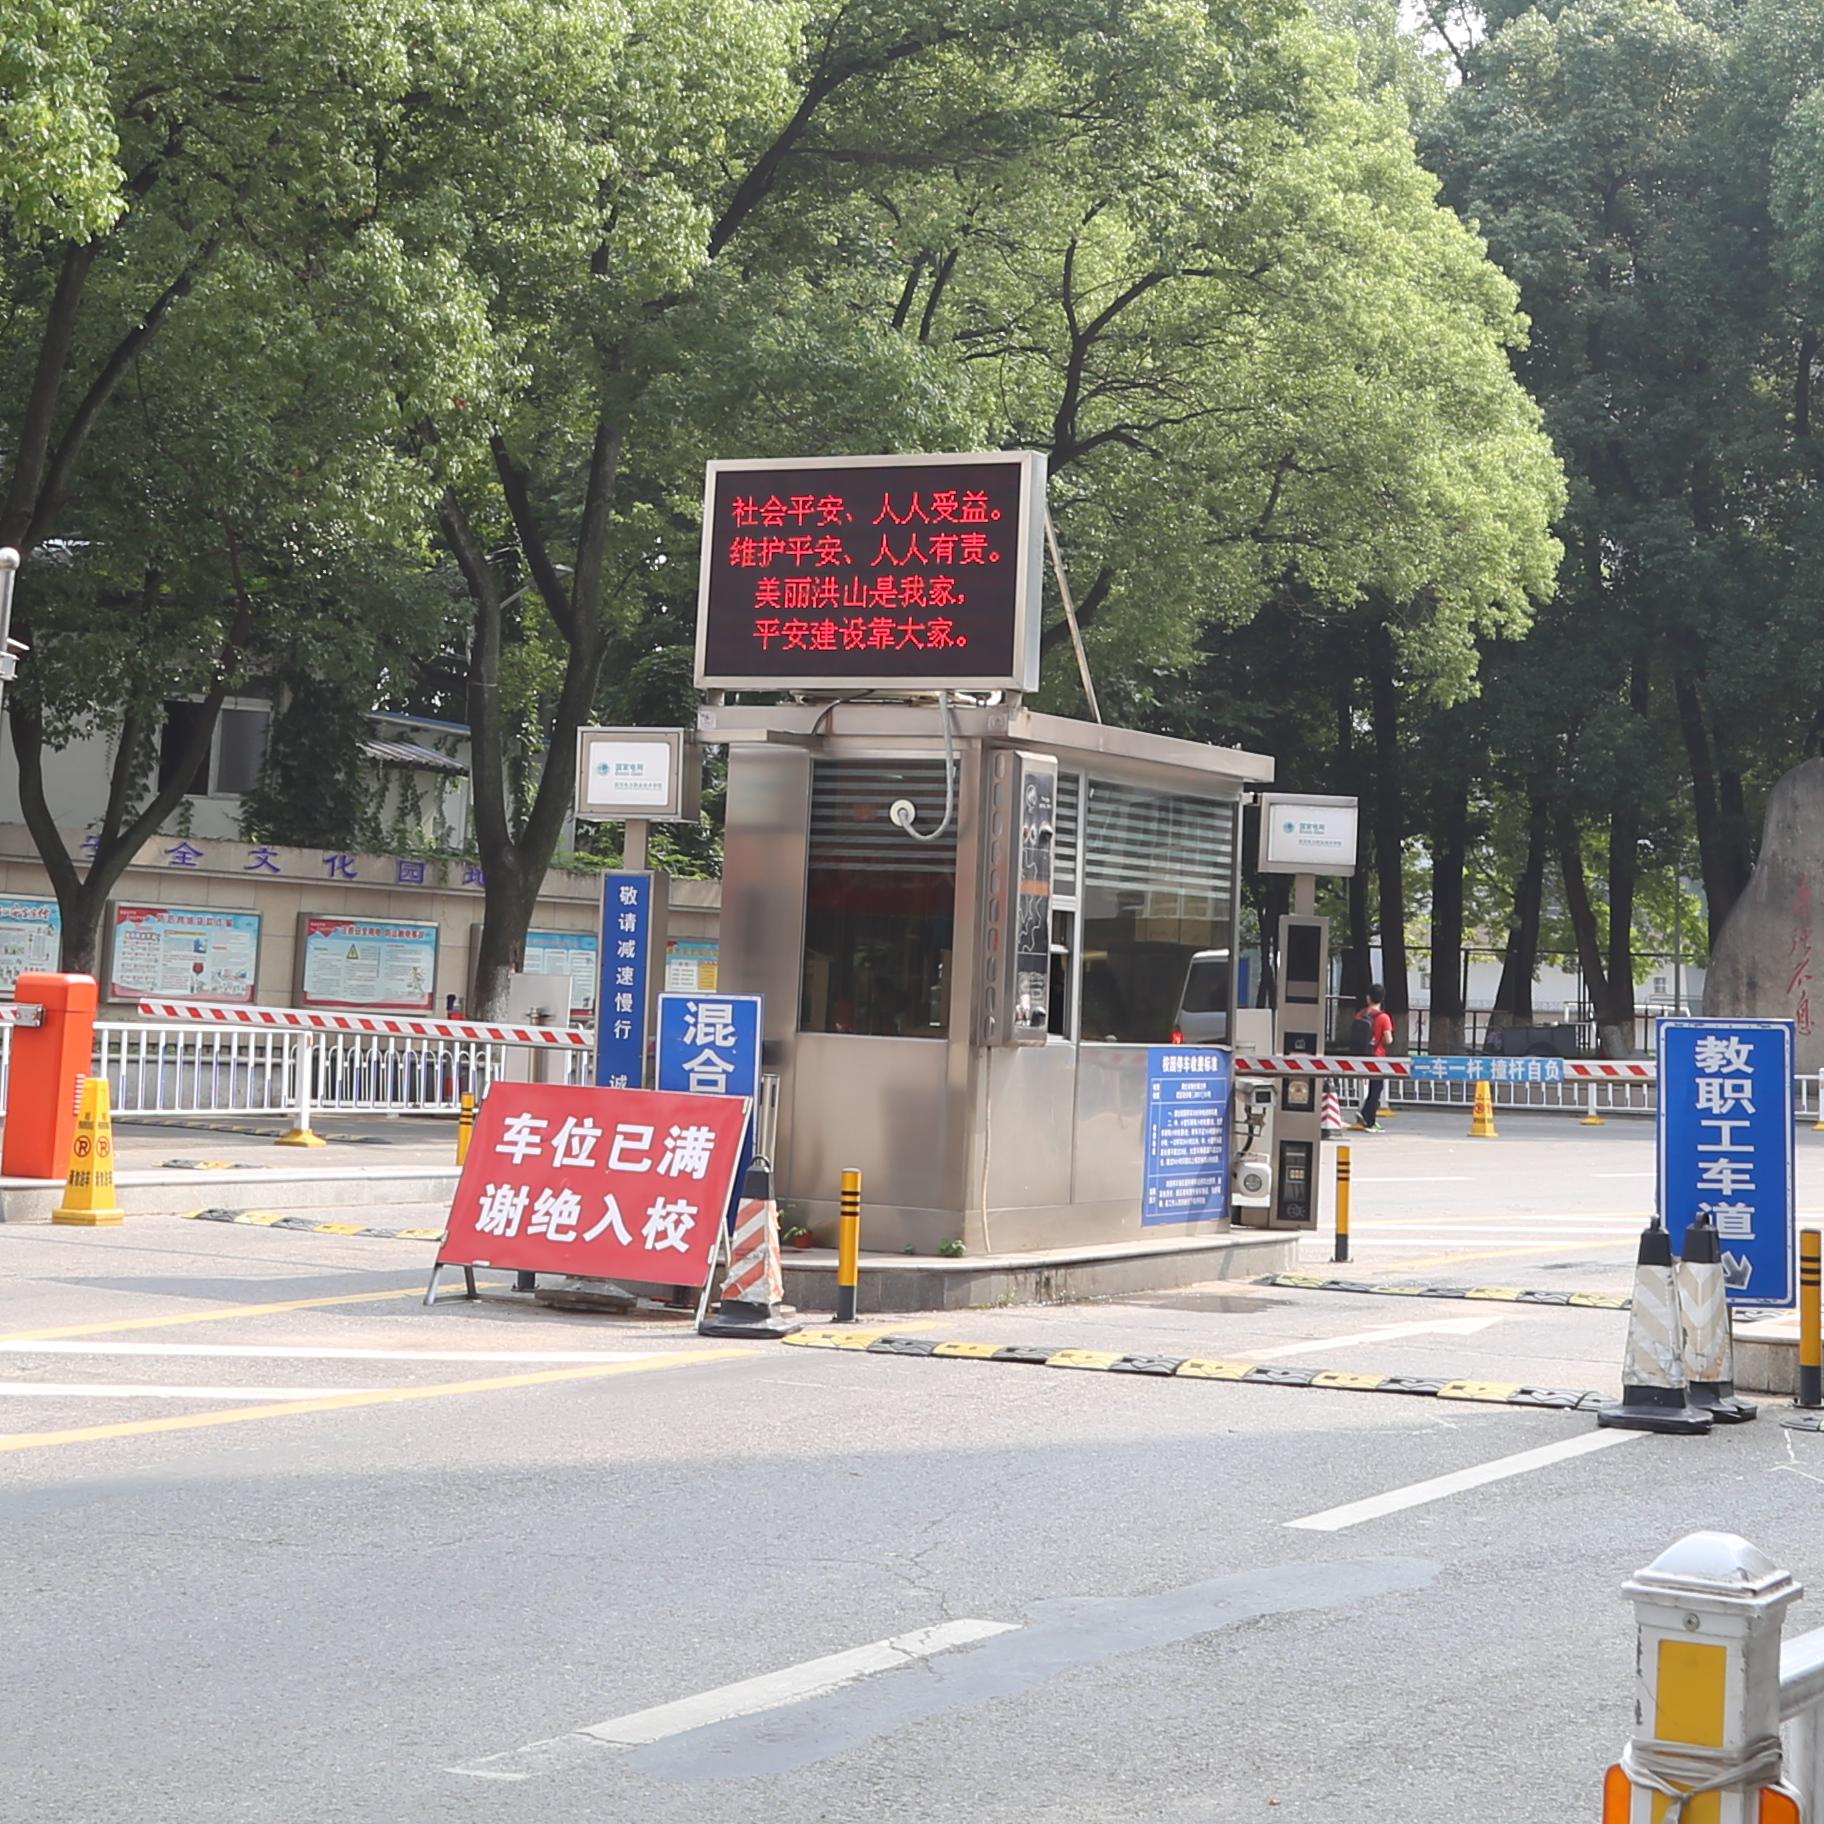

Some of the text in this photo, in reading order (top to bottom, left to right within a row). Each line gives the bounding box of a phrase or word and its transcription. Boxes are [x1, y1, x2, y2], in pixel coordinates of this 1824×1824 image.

[752, 617, 968, 651] 平安建设靠大家。
[613, 885, 638, 1040] 敬请减速慢行
[682, 1001, 738, 1094] 混合
[495, 1112, 715, 1181] 车位已满
[1694, 1035, 1756, 1241] 教职工车道
[475, 1183, 699, 1253] 谢绝入校
